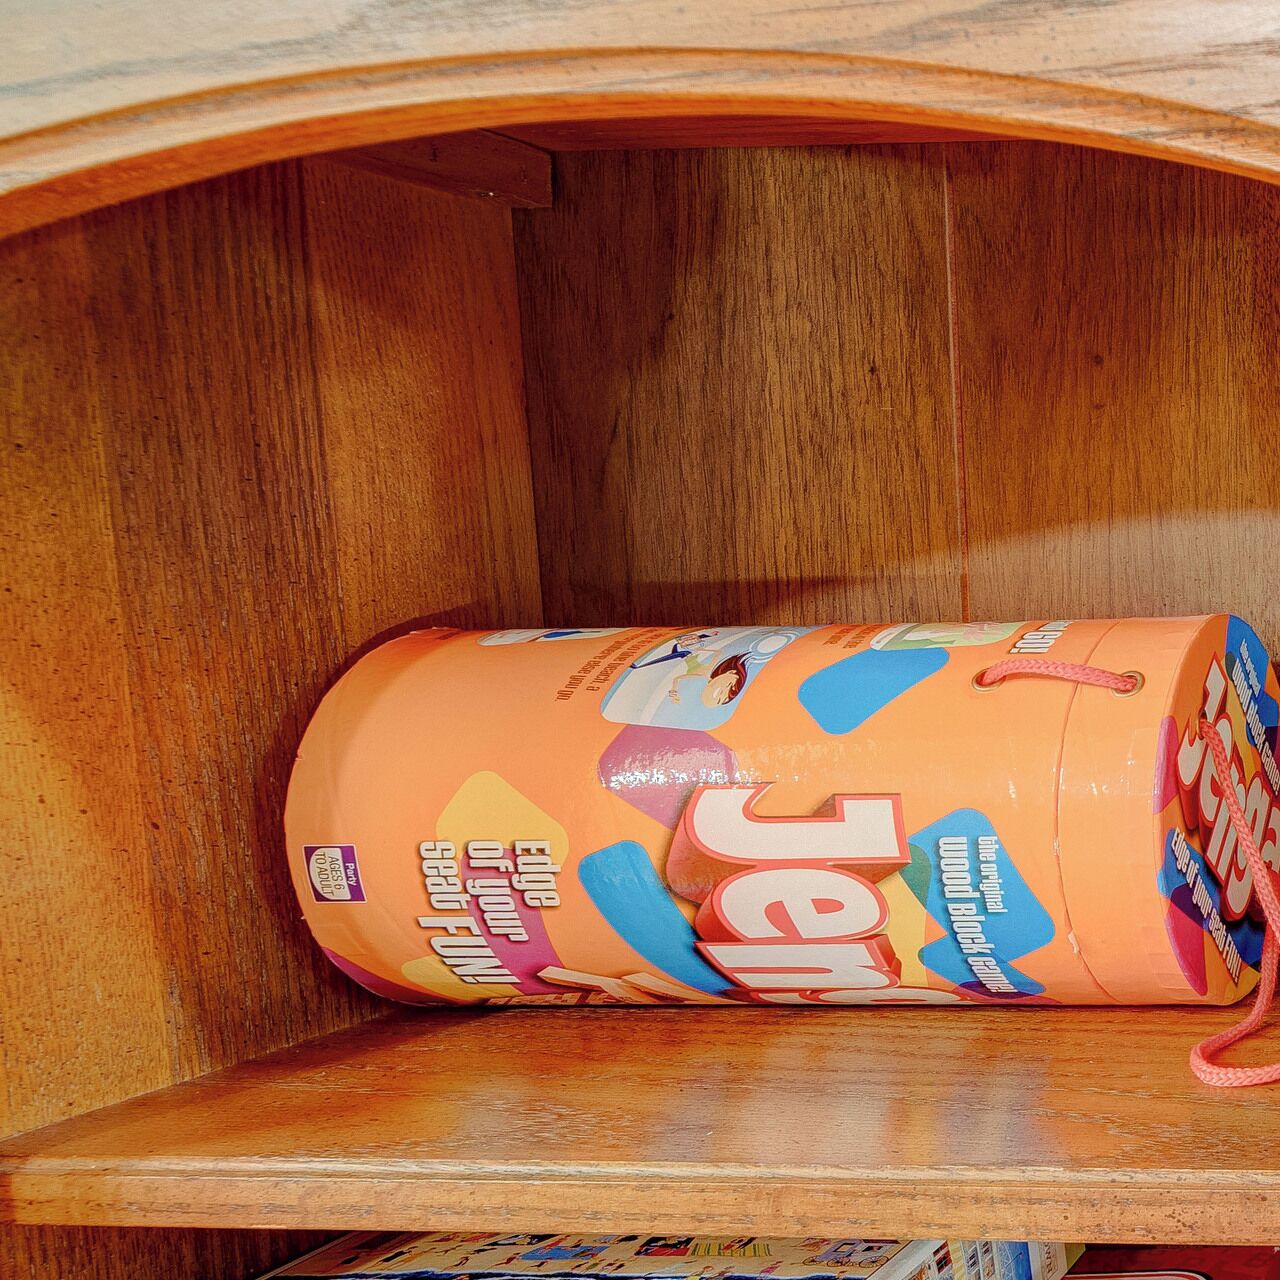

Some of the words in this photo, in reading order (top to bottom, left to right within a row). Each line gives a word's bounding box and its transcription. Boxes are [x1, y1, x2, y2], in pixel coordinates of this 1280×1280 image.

[314, 852, 327, 865] TO
[467, 840, 515, 872] of
[939, 836, 981, 898] wood
[977, 836, 999, 861] the
[316, 866, 335, 897] ADULT
[328, 856, 344, 883] AGES
[345, 863, 358, 887] Party
[419, 841, 472, 910] seat
[511, 840, 562, 907] Edge
[979, 863, 1009, 914] original
[465, 878, 530, 942] your
[416, 915, 523, 984] FUN!
